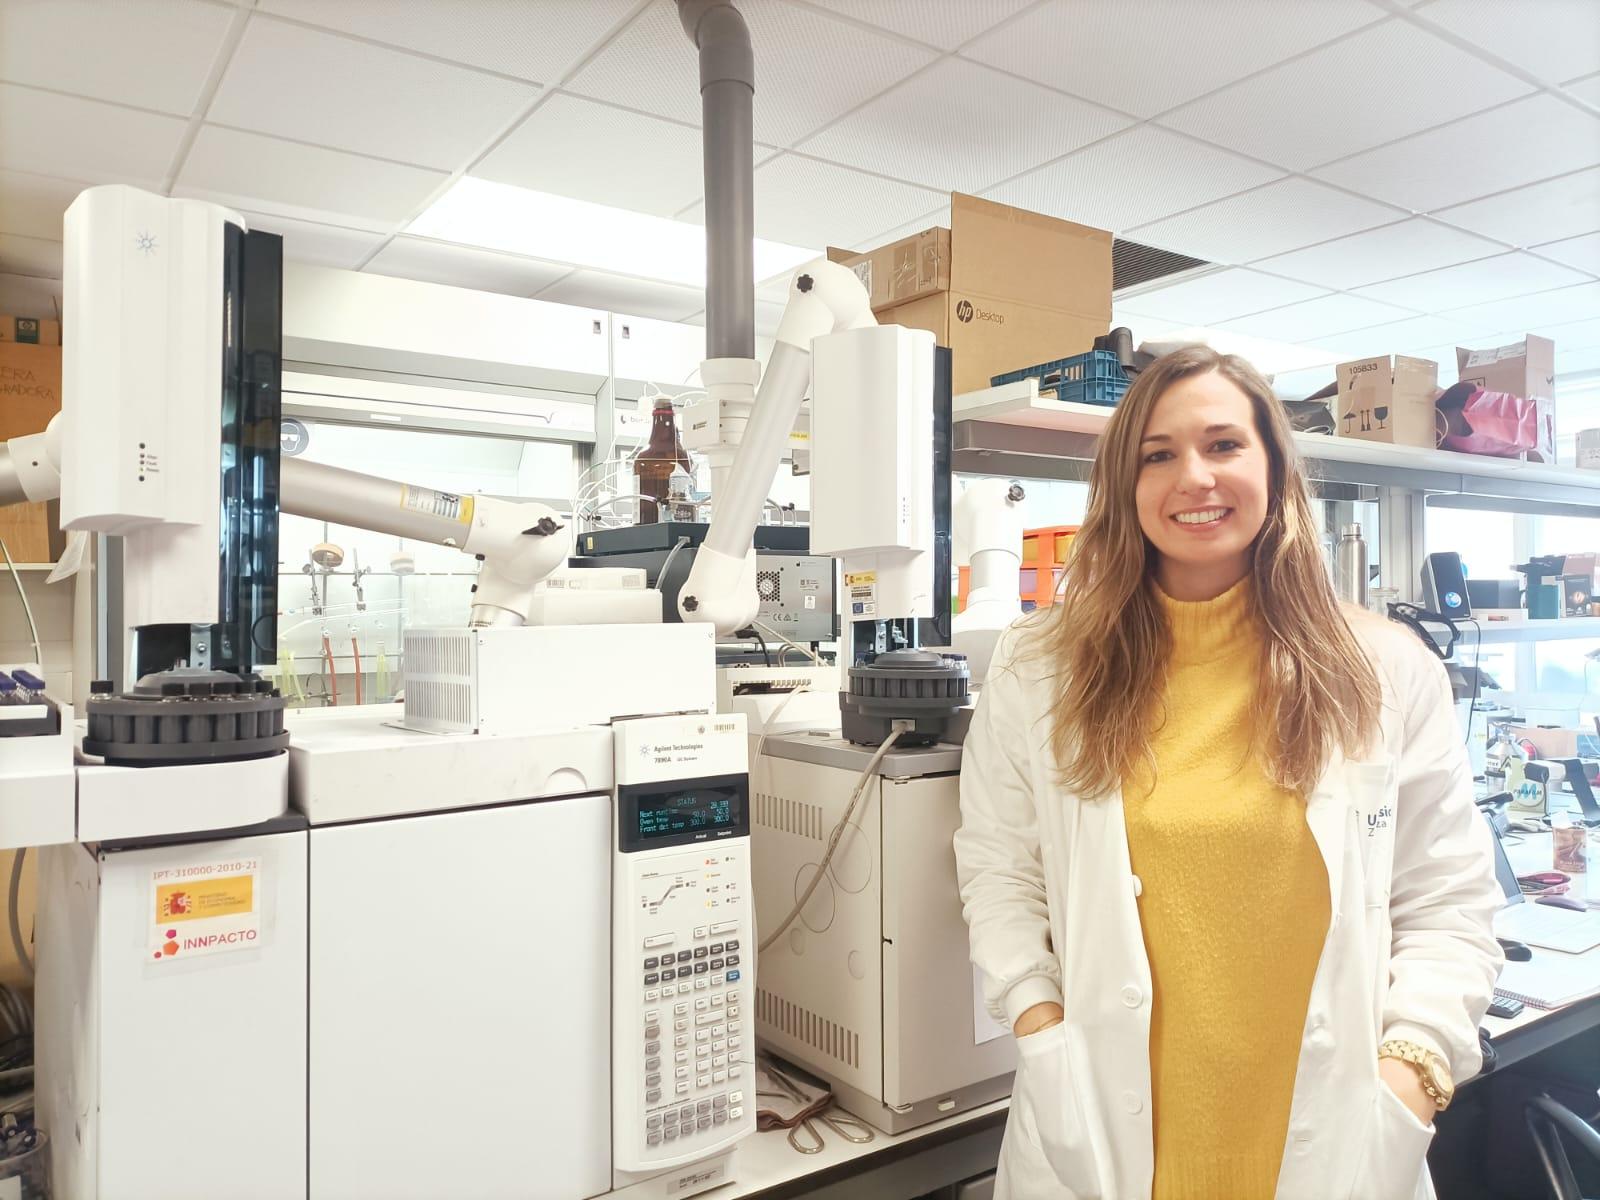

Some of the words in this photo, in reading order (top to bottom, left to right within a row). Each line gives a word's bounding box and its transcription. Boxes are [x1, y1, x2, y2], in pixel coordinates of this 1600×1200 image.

[957, 300, 973, 323] hp
[976, 309, 1004, 324] Desktop
[1349, 363, 1378, 374] 105833
[654, 745, 671, 753] Agilent
[673, 743, 703, 752] Technologies
[639, 810, 653, 818] Next
[152, 861, 257, 880] IPT-310000-2010-21
[183, 929, 257, 950] INNPACTO
